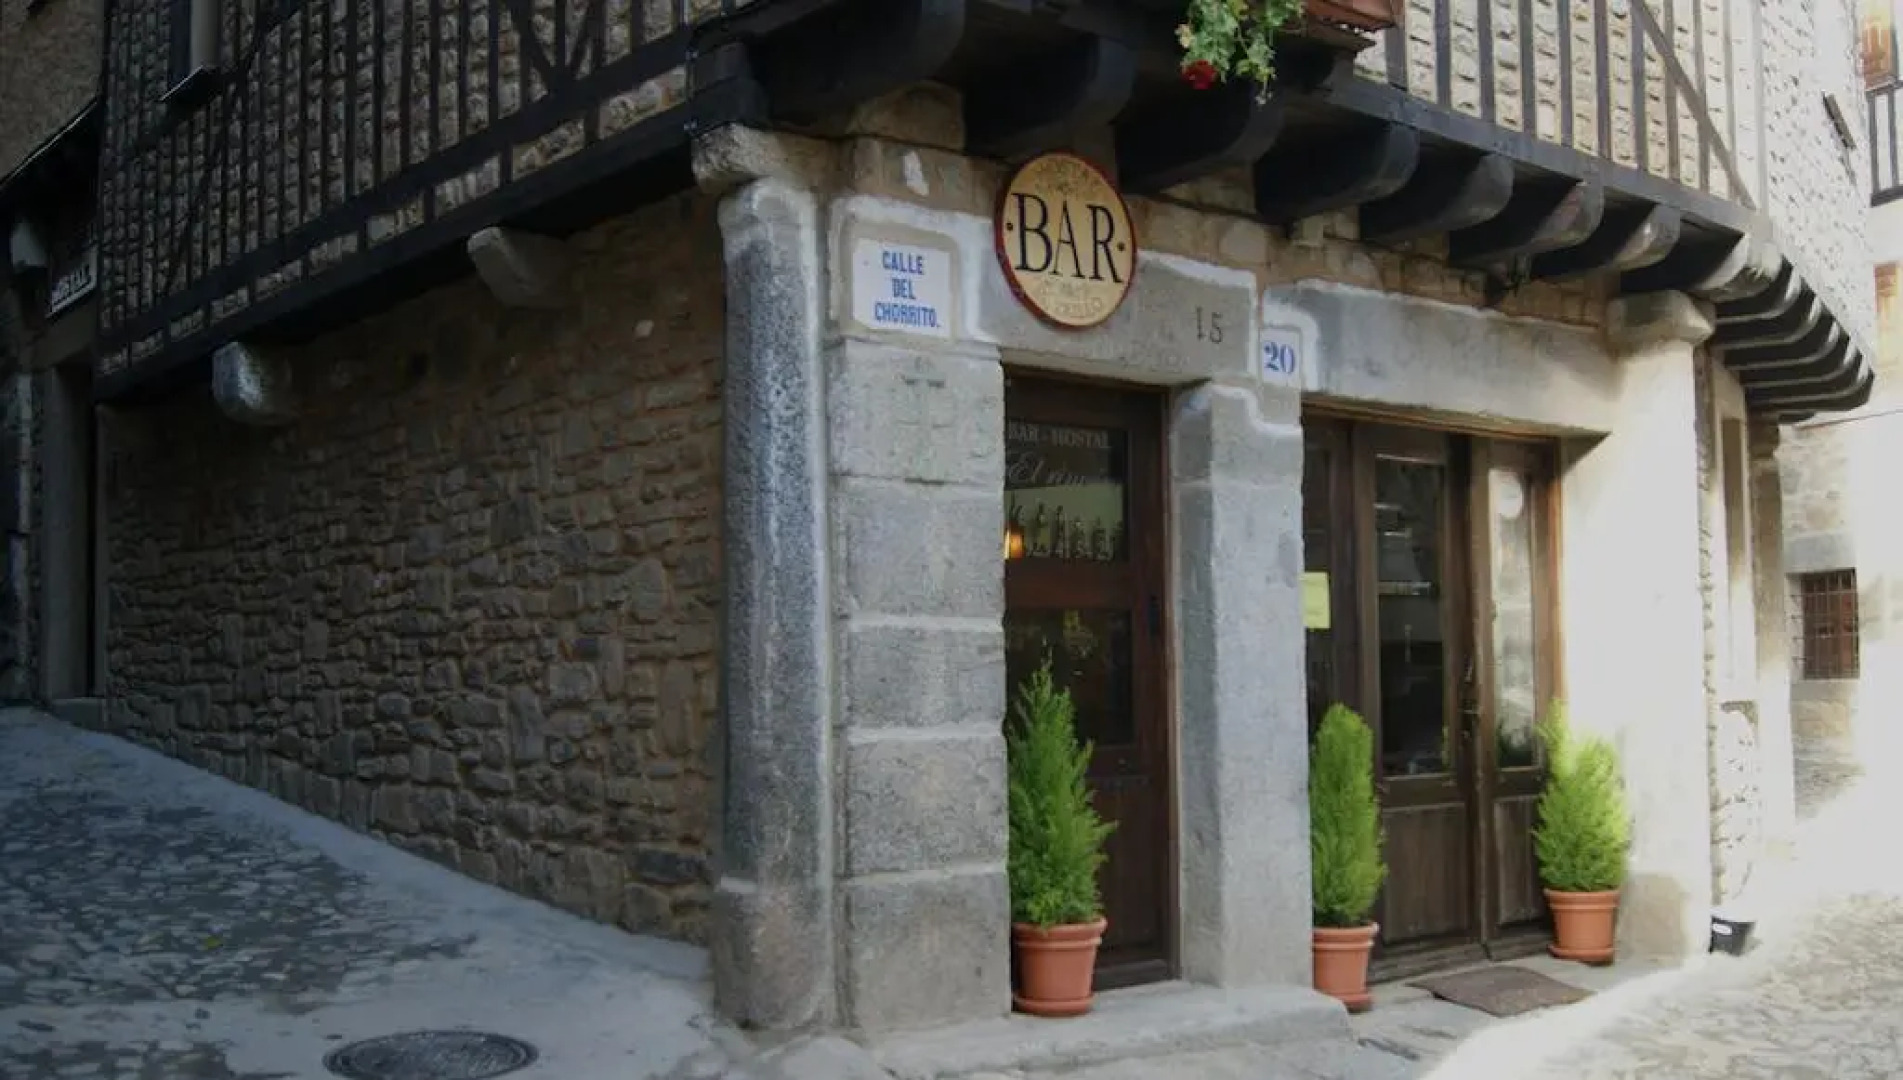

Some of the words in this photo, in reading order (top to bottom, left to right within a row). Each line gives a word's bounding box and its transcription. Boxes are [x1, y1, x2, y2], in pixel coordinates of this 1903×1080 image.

[1010, 192, 1123, 283] BAR
[882, 250, 924, 275] CALLE
[892, 277, 916, 300] DEL
[1196, 305, 1223, 344] 15
[1263, 341, 1294, 375] 20
[1008, 420, 1040, 443] BAR
[1051, 428, 1112, 449] HOSTAL
